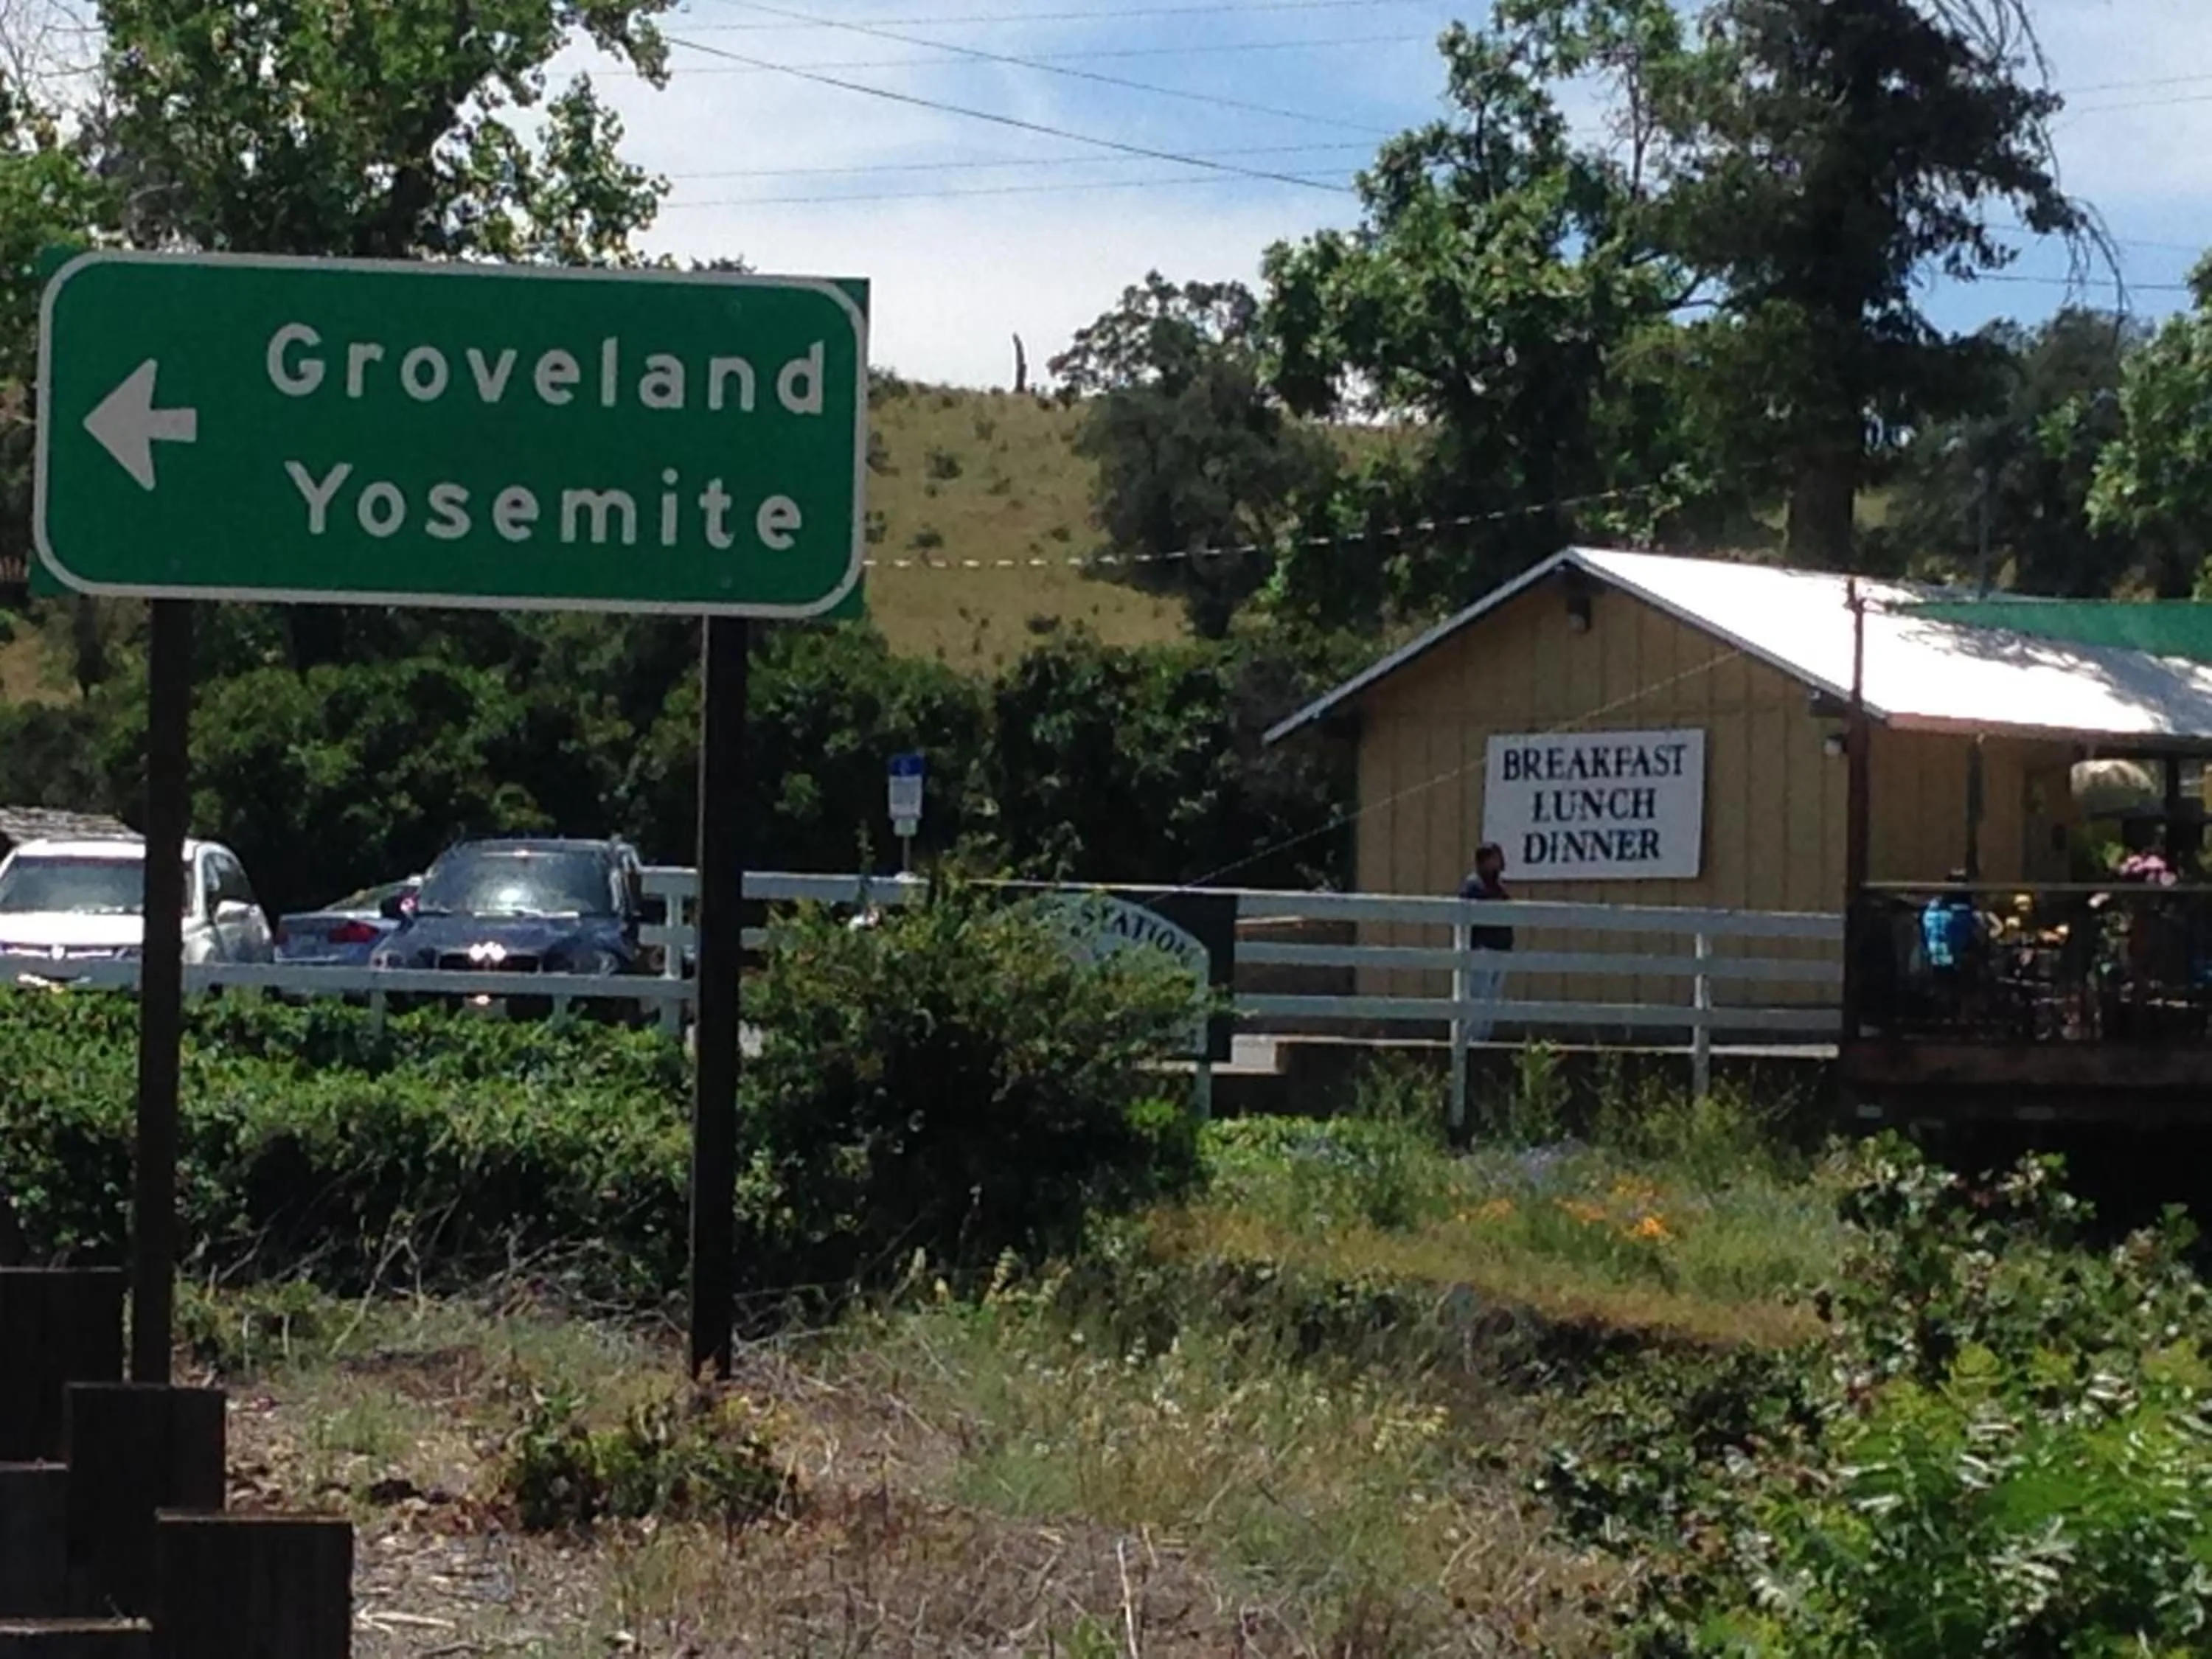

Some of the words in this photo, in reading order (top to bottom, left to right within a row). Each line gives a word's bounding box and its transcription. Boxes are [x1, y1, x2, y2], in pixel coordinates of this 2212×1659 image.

[266, 322, 824, 414] Groveland
[285, 461, 801, 549] Yosemite
[1503, 744, 1687, 780] BREAKFAST
[1532, 787, 1656, 822] LUNCH
[1523, 828, 1660, 864] DINNER
